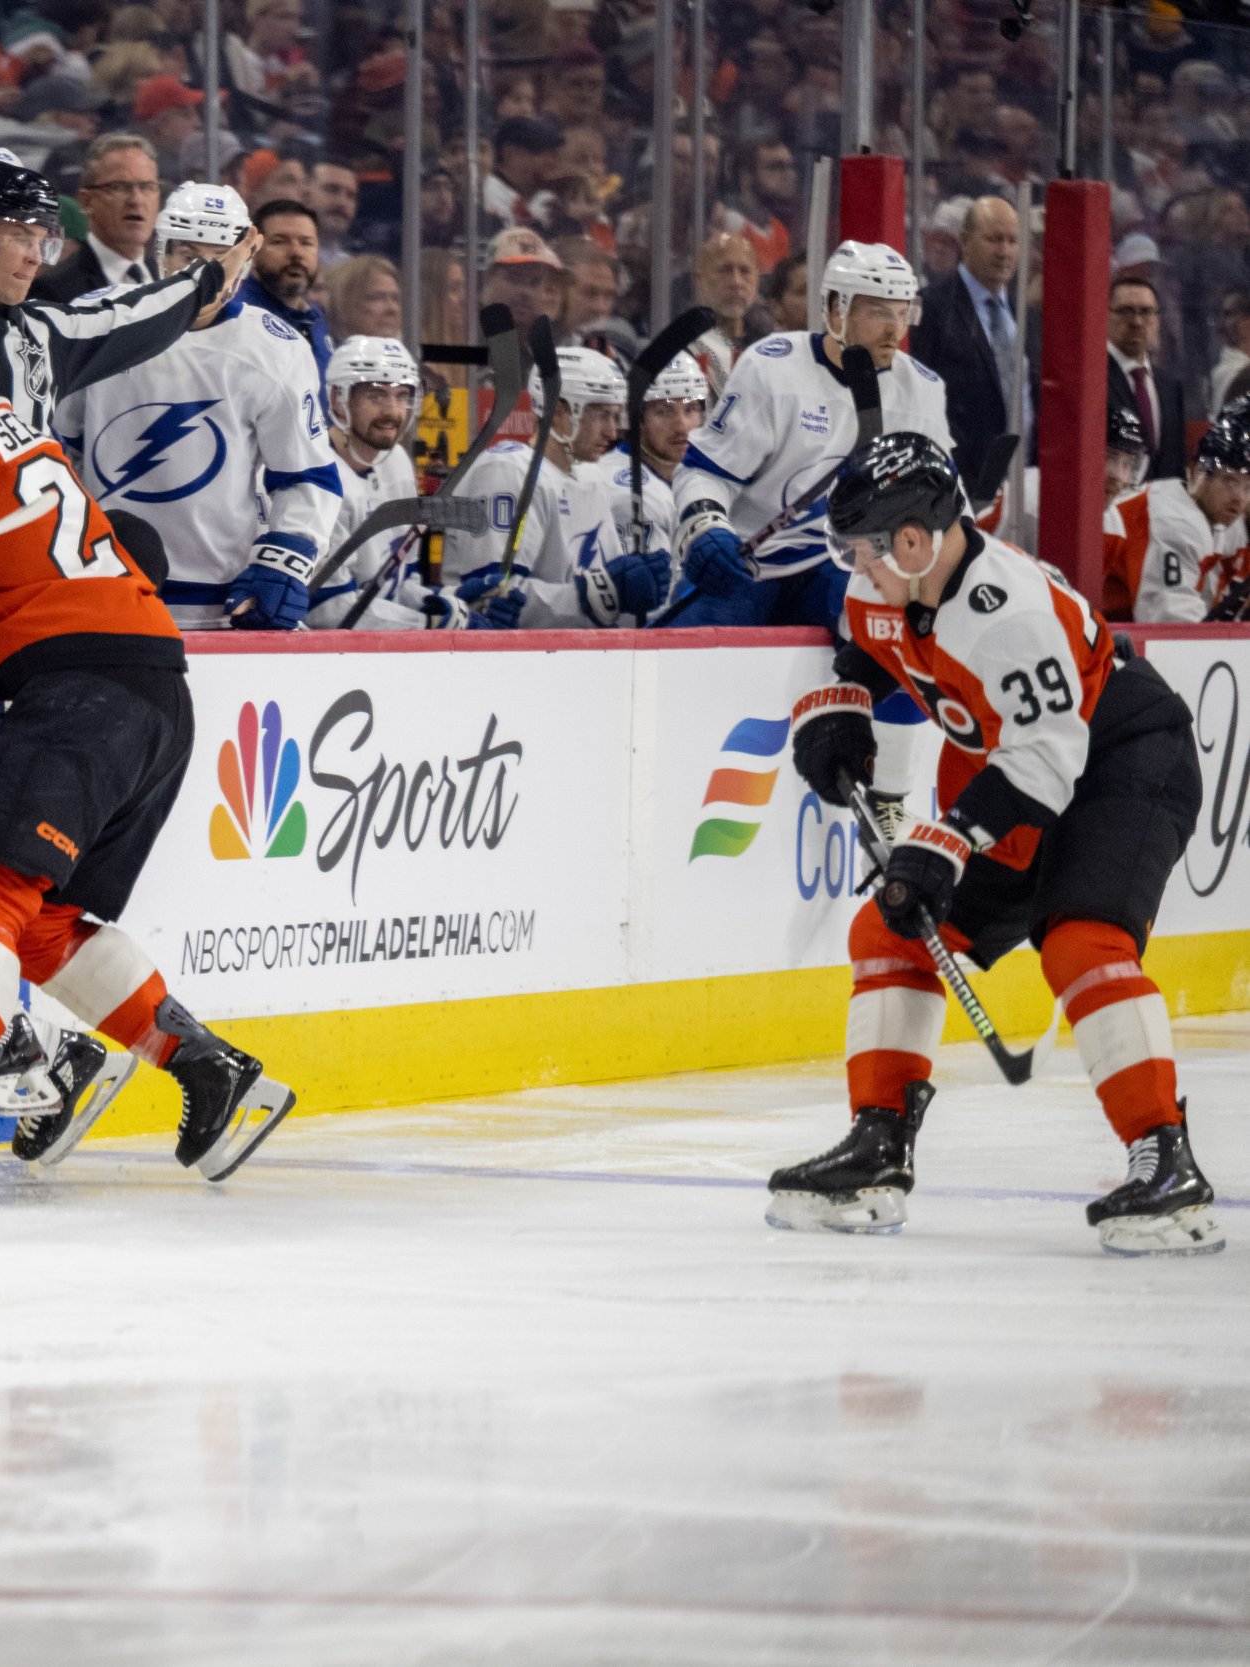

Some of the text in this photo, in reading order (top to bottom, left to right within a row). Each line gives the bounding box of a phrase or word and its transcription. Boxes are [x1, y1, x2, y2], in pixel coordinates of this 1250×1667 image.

[198, 219, 231, 229] CCM
[302, 389, 329, 441] 2
[1163, 551, 1182, 587] 8
[976, 585, 999, 611] 1
[866, 616, 903, 643] IBX
[1000, 657, 1074, 727] 39
[308, 688, 524, 908] Sports
[35, 820, 80, 862] CCM
[180, 908, 537, 977] NBCSPORTSPHILADELPHIA.COM
